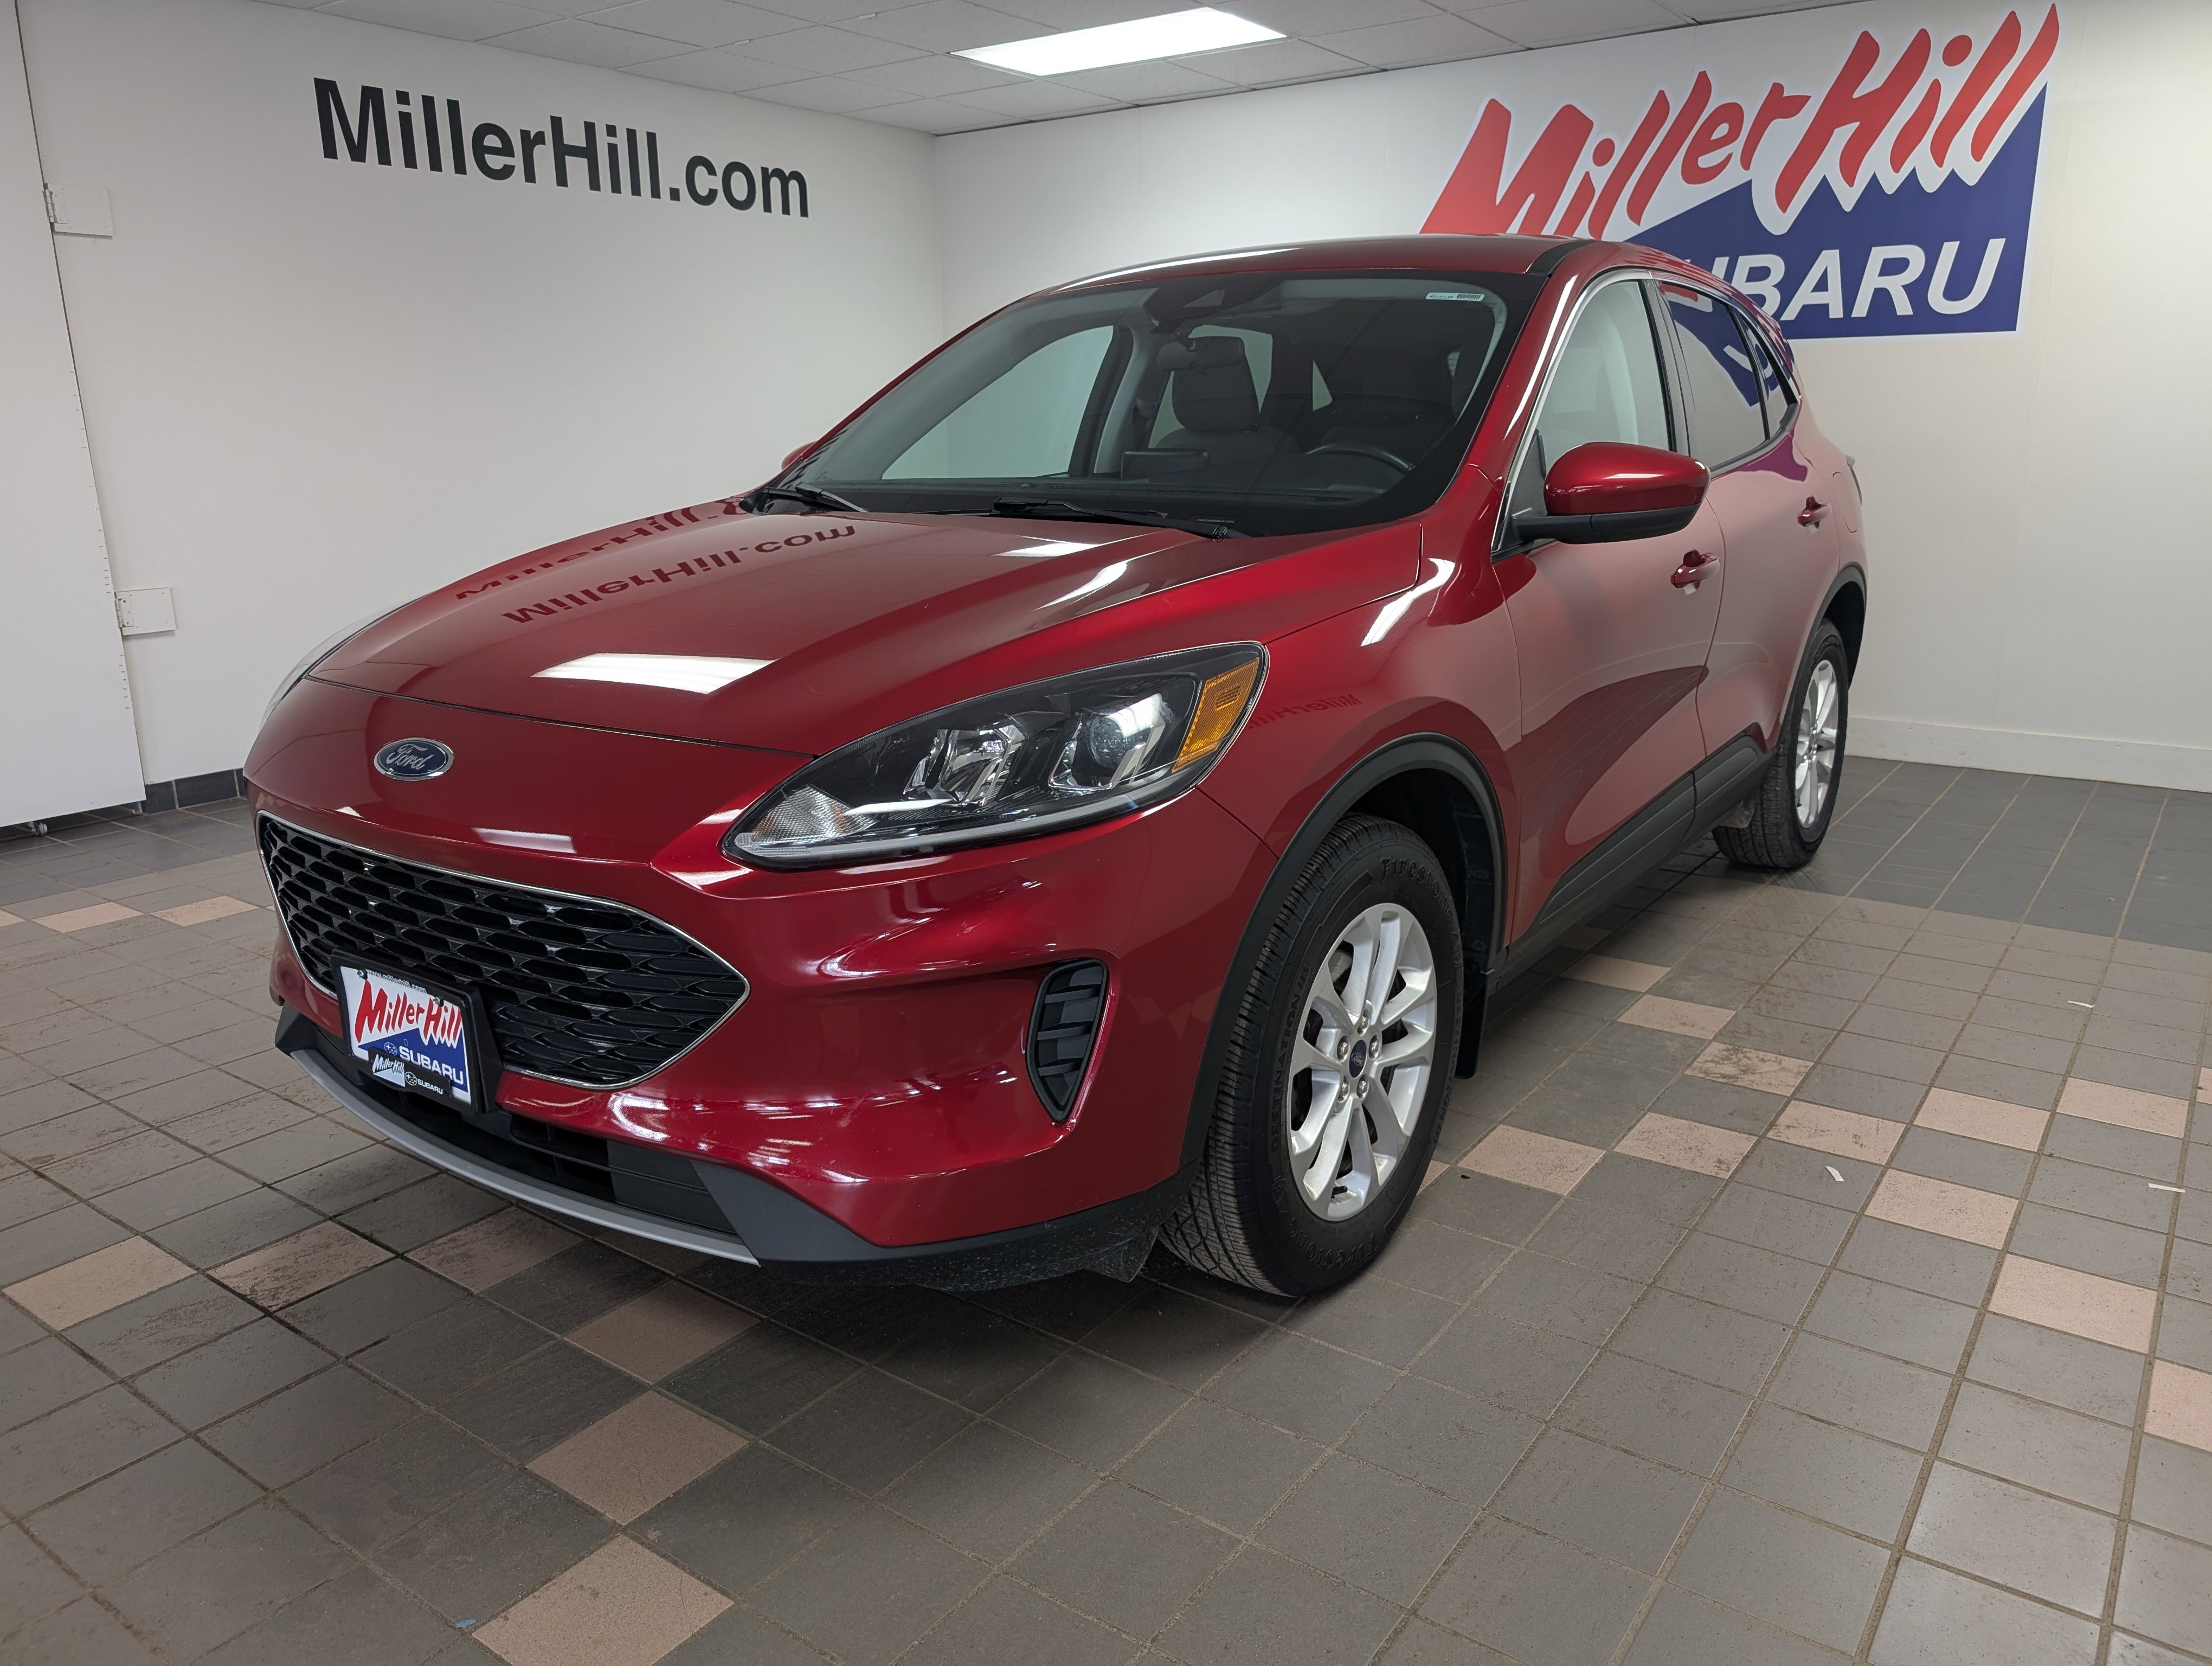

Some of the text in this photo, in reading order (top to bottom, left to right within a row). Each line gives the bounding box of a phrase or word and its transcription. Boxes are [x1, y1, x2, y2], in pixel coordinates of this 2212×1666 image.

[313, 77, 809, 217] MillerHill.com
[1688, 238, 2007, 321] BARU
[386, 744, 434, 770] Ford
[399, 1046, 464, 1085] SUBARU
[417, 1079, 443, 1095] SUBARU
